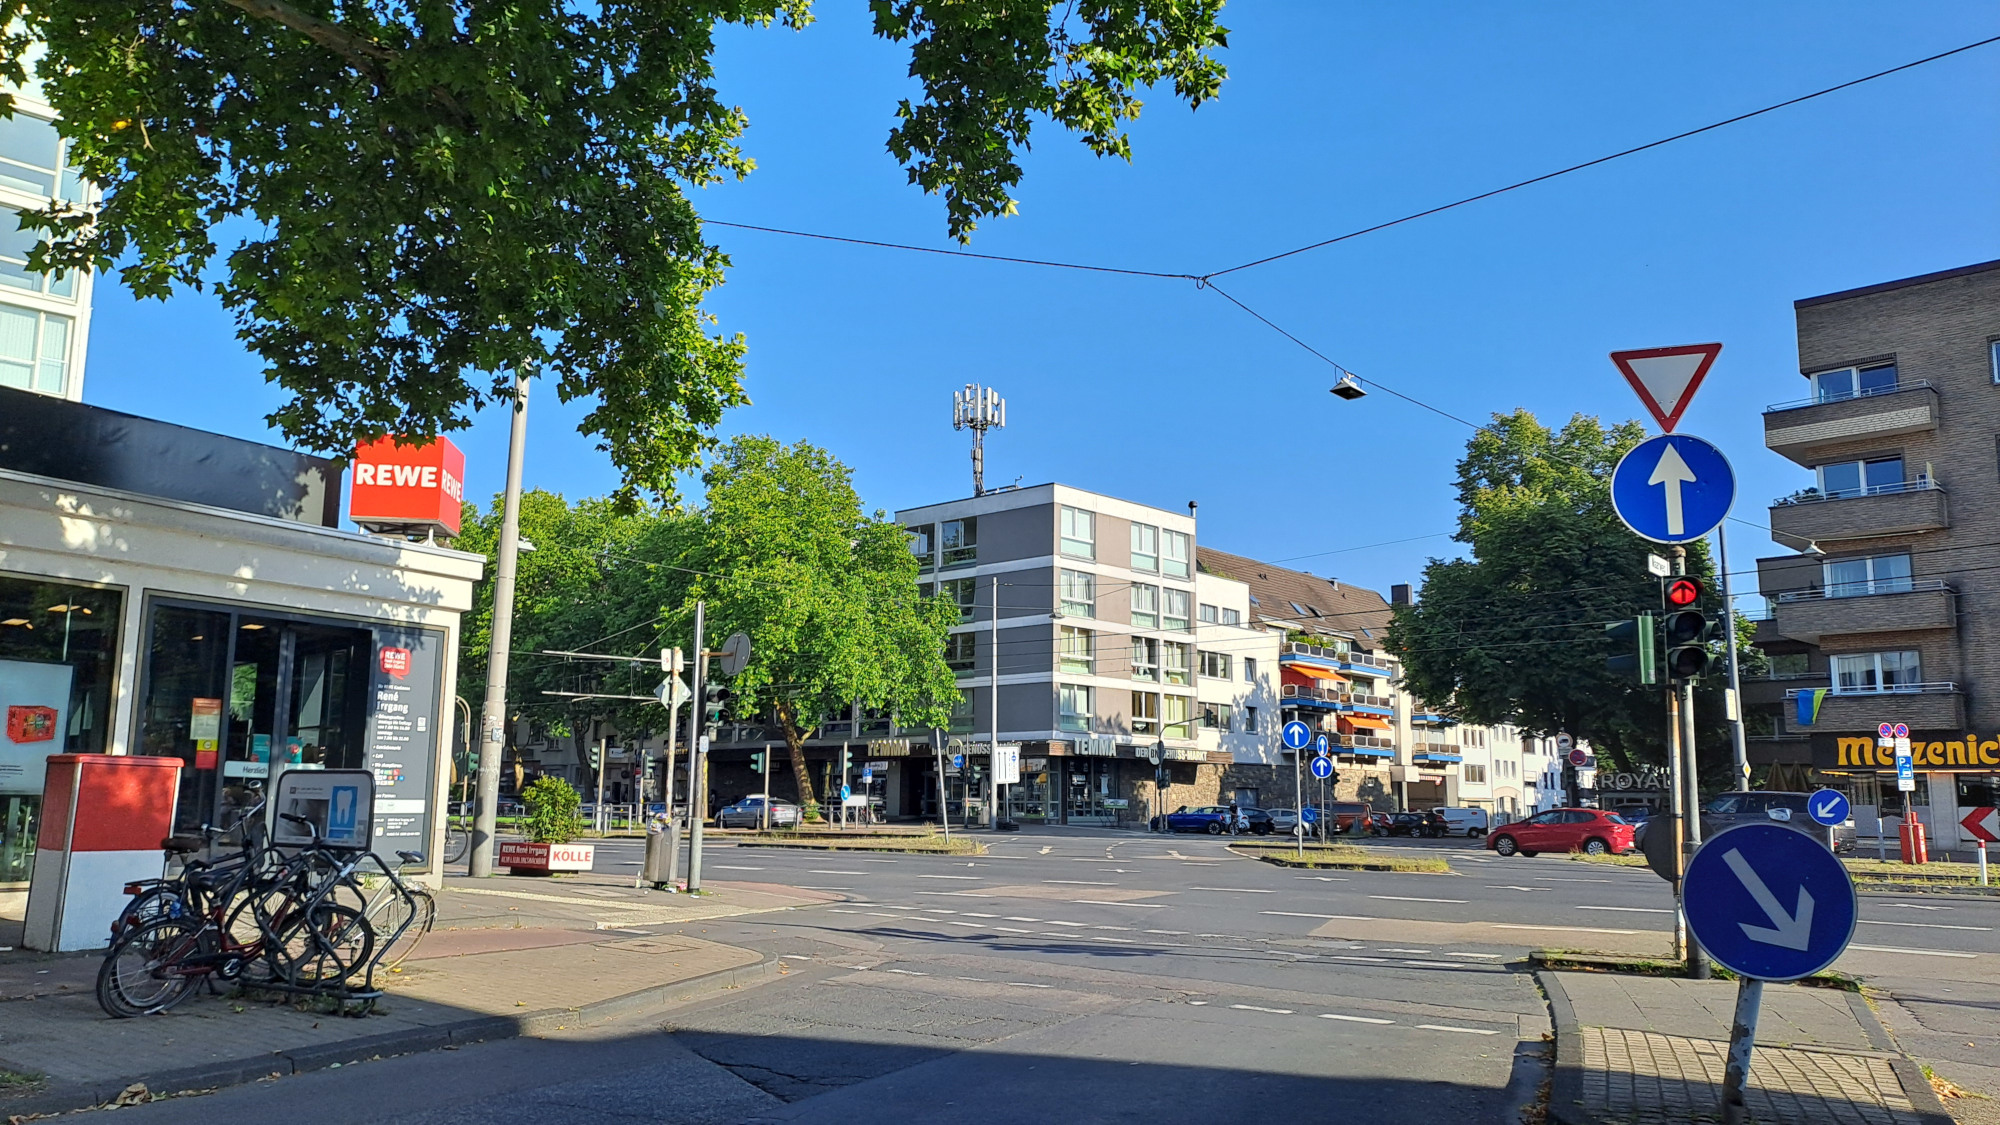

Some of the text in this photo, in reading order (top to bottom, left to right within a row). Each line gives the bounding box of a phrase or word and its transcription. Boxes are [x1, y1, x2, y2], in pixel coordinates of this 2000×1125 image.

[356, 463, 437, 487] REWE
[441, 468, 462, 503] REWE
[384, 651, 406, 660] REWE
[377, 691, 399, 701] René
[376, 701, 409, 714] Irrgang
[867, 739, 910, 757] TEMMA
[931, 747, 946, 756] DR
[948, 745, 961, 755] BIO
[1074, 736, 1117, 757] TEMMA
[1135, 747, 1149, 758] DER
[1836, 733, 2000, 766] Mezenic
[243, 765, 268, 775] Herzlich
[1601, 772, 1671, 789] ROYAL
[502, 845, 548, 857] REWE René Irrgang
[552, 847, 591, 863] KÖLLE
